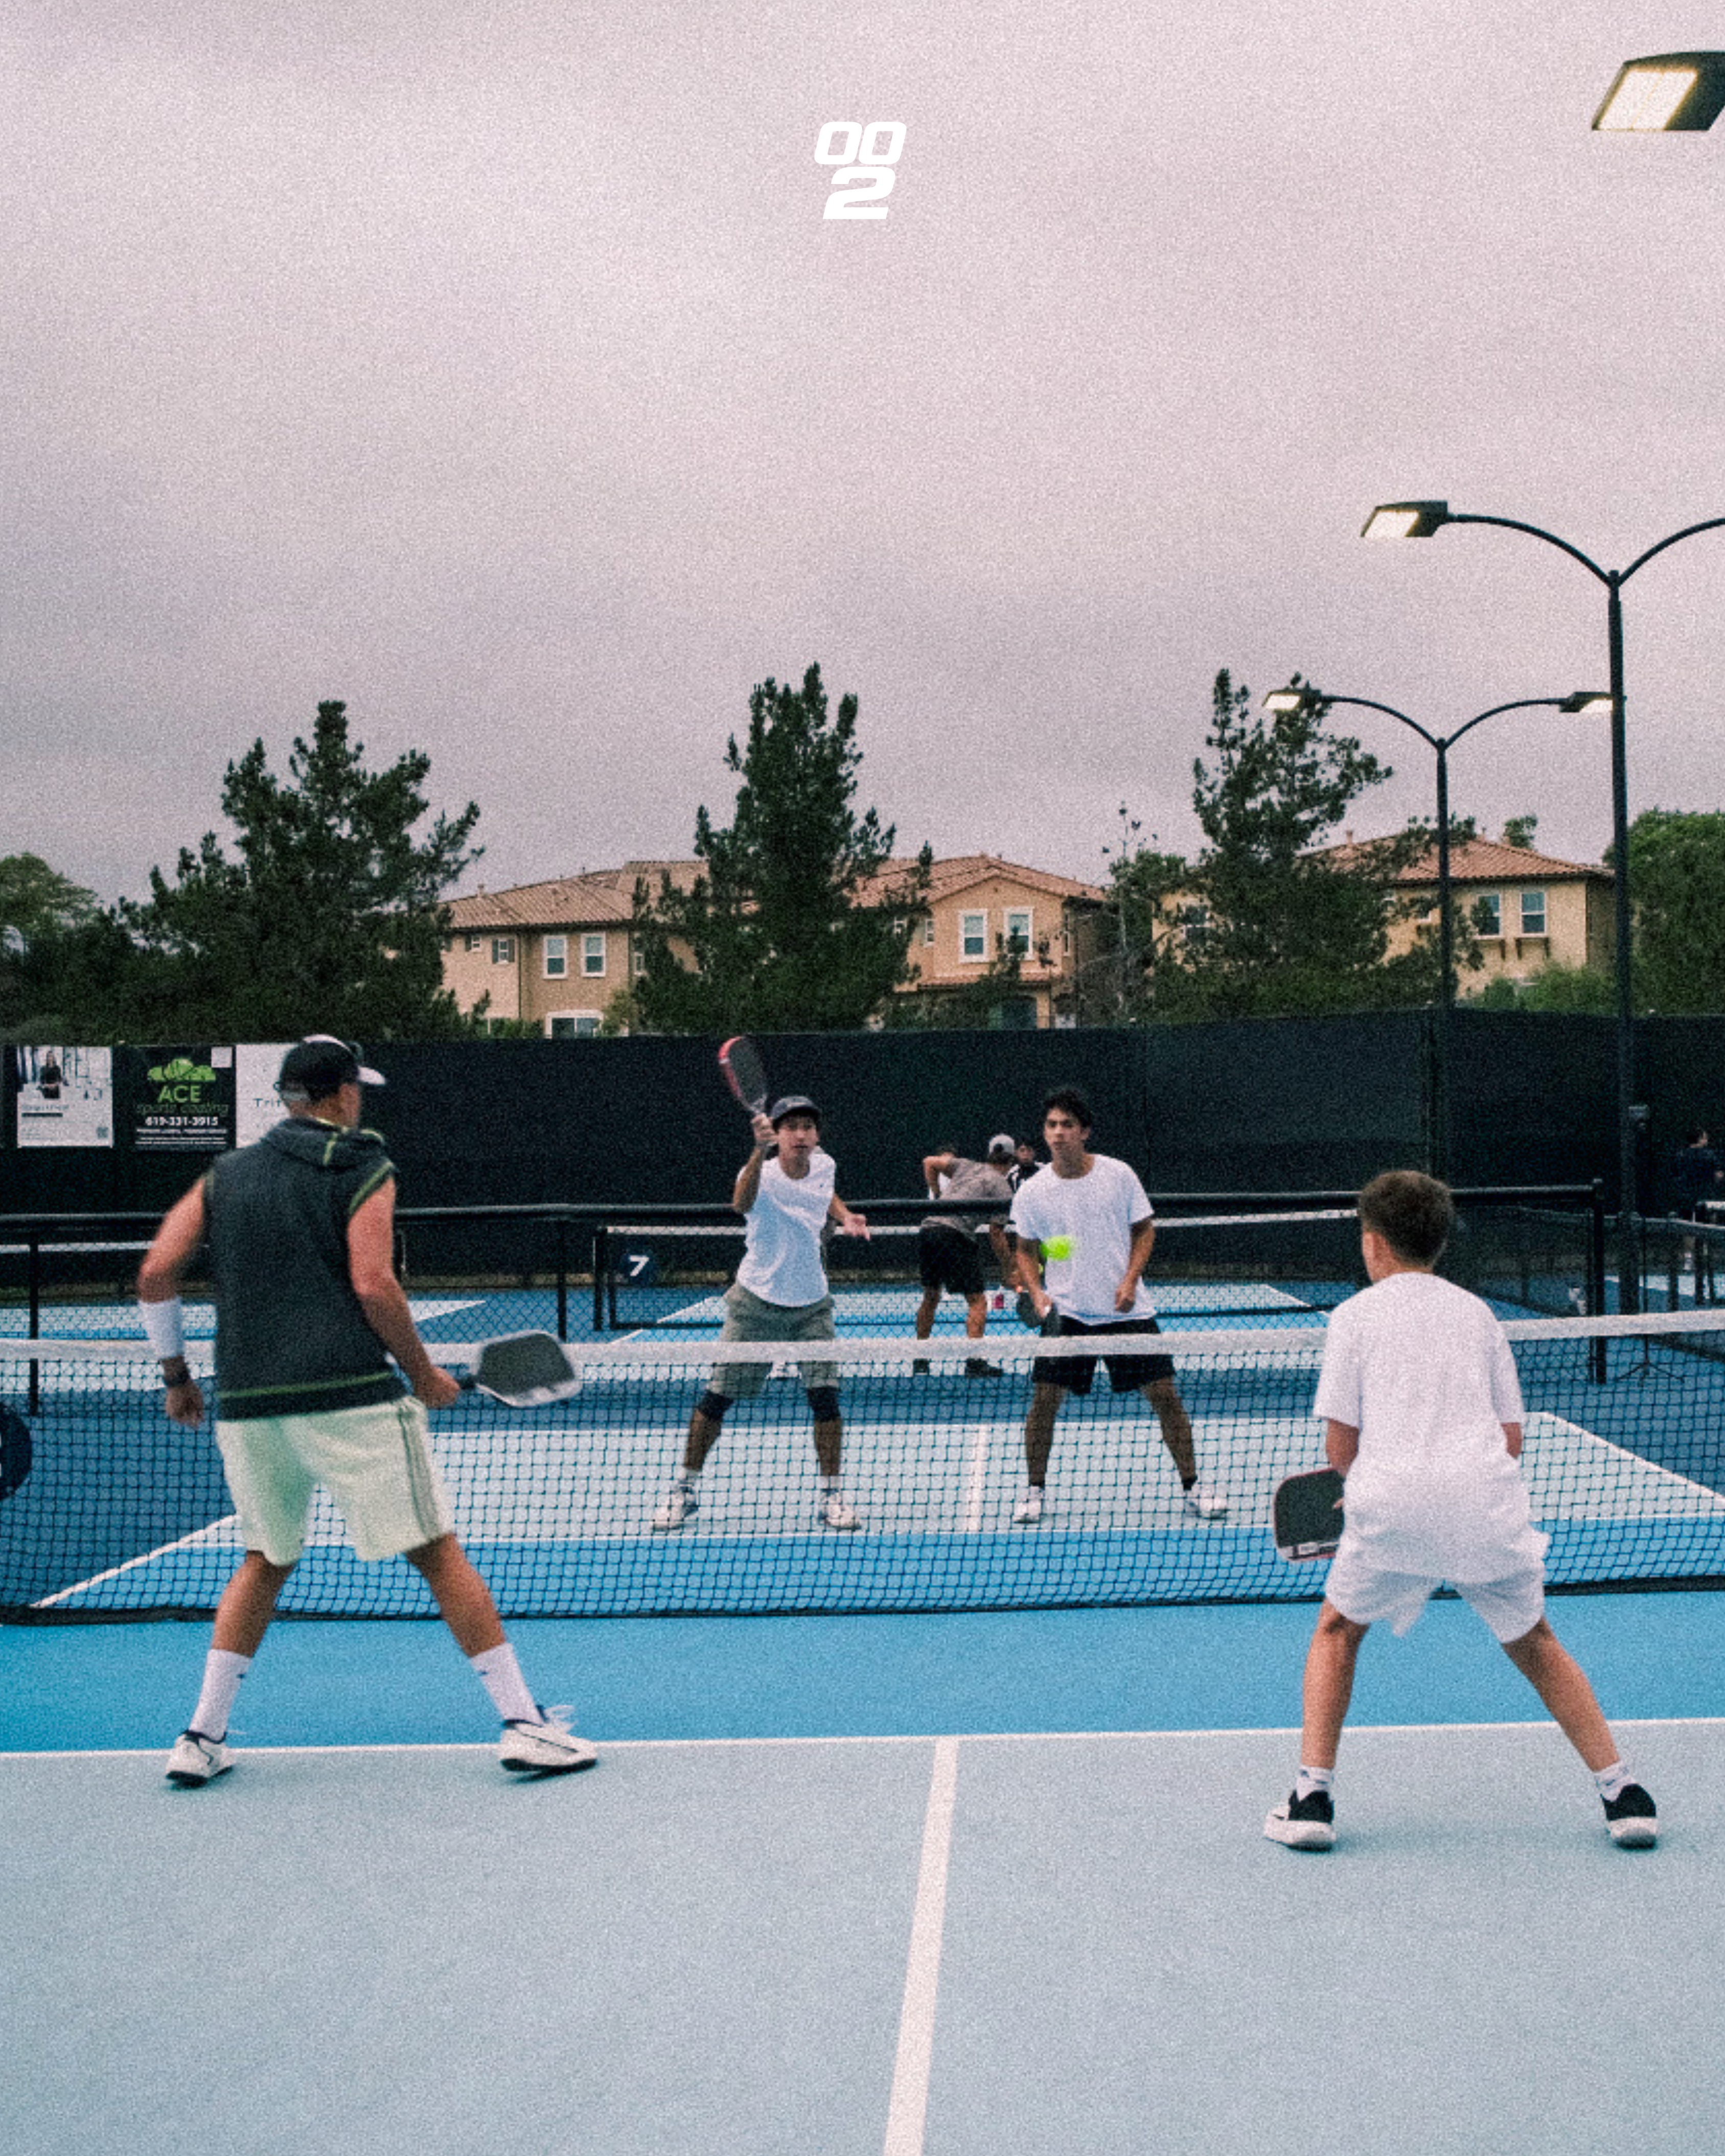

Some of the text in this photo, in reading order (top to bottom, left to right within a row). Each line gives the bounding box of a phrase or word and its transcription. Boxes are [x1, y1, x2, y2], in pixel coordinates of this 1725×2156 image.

[157, 1085, 201, 1103] ACE
[145, 1117, 219, 1126] 619-331-3915
[628, 1255, 649, 1277] 7
